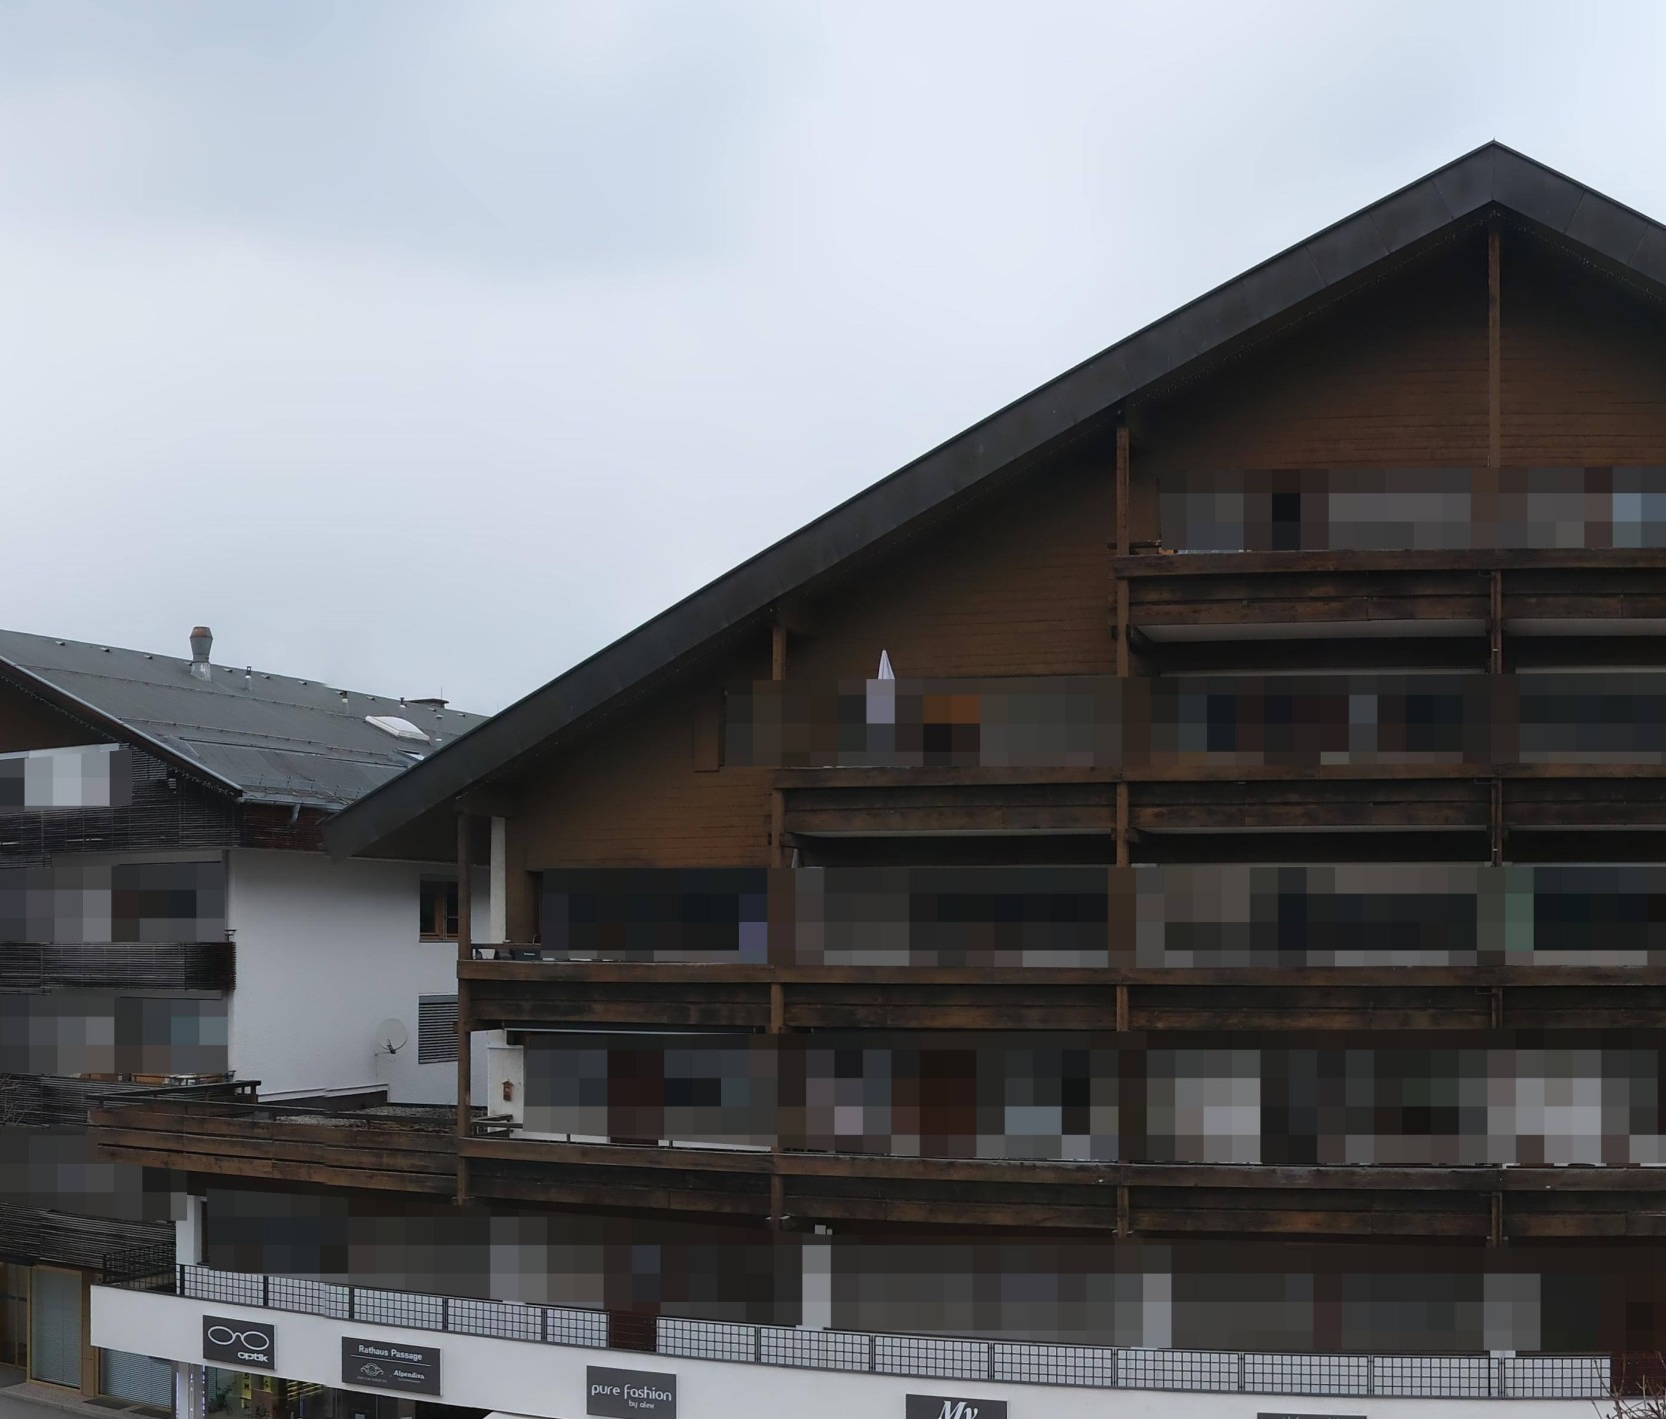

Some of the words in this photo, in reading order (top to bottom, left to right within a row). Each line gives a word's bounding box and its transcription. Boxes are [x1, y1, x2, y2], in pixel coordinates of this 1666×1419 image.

[238, 1351, 269, 1362] optik
[358, 1345, 389, 1357] Rathaus
[391, 1349, 423, 1361] Passage
[592, 1384, 620, 1396] pure
[624, 1384, 672, 1401] fashion
[629, 1400, 638, 1409] by
